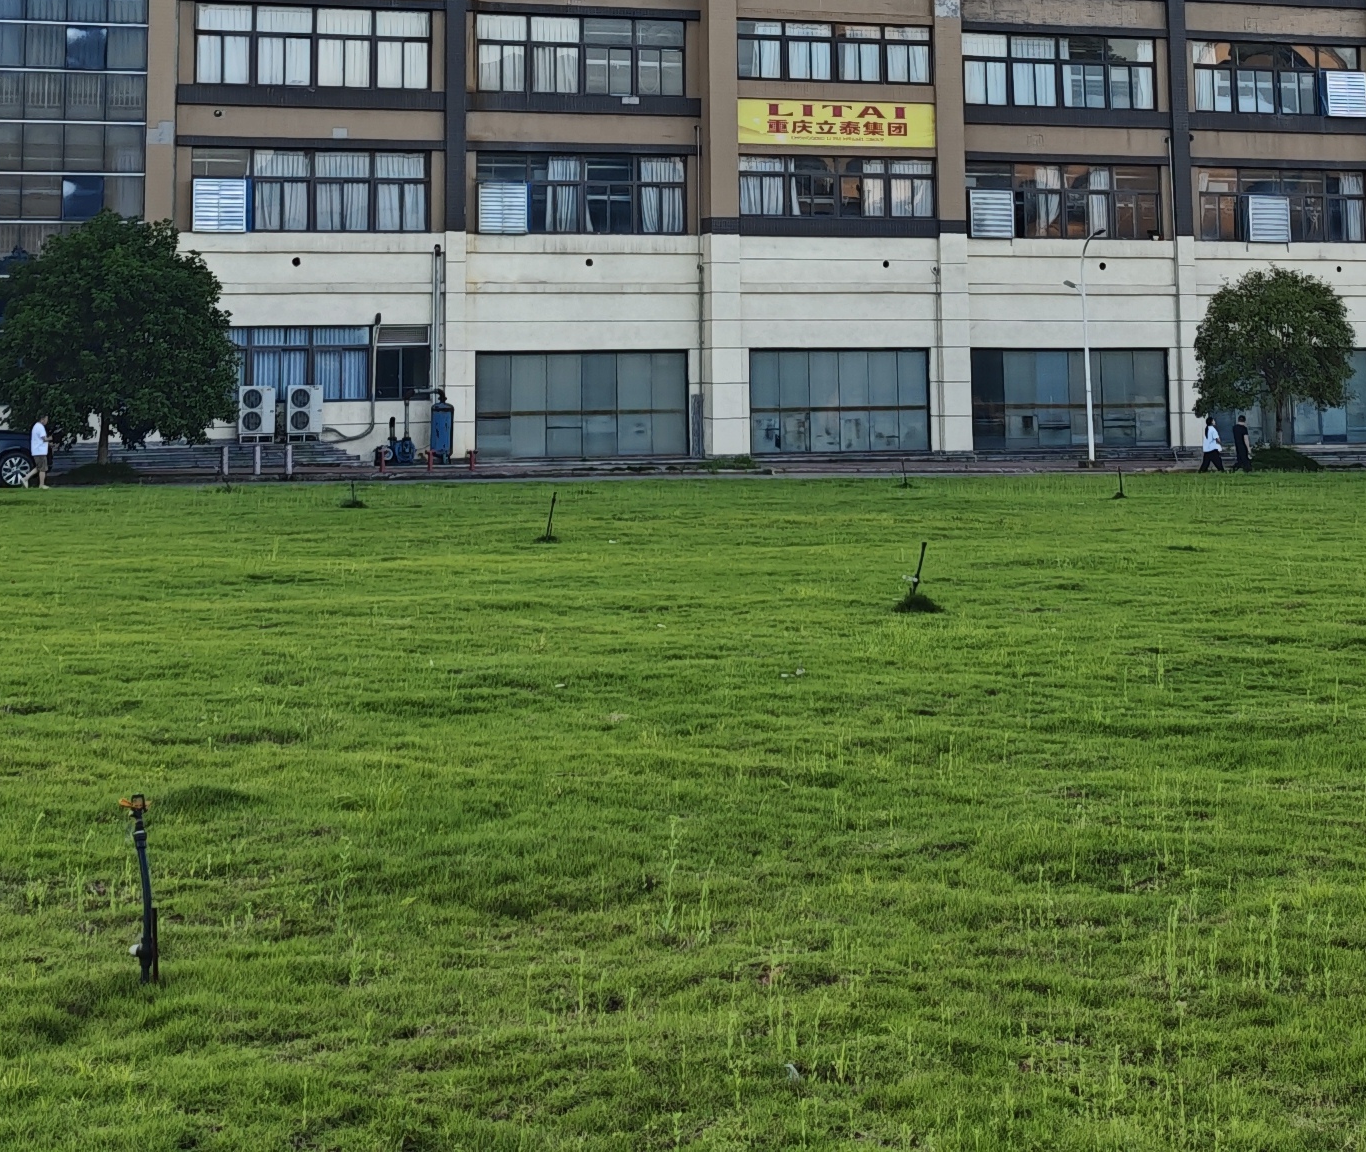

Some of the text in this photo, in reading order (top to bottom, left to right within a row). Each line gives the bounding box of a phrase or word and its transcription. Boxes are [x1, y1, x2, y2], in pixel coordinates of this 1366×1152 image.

[766, 103, 906, 119] LITAI
[767, 119, 907, 136] 重庆立泰集团
